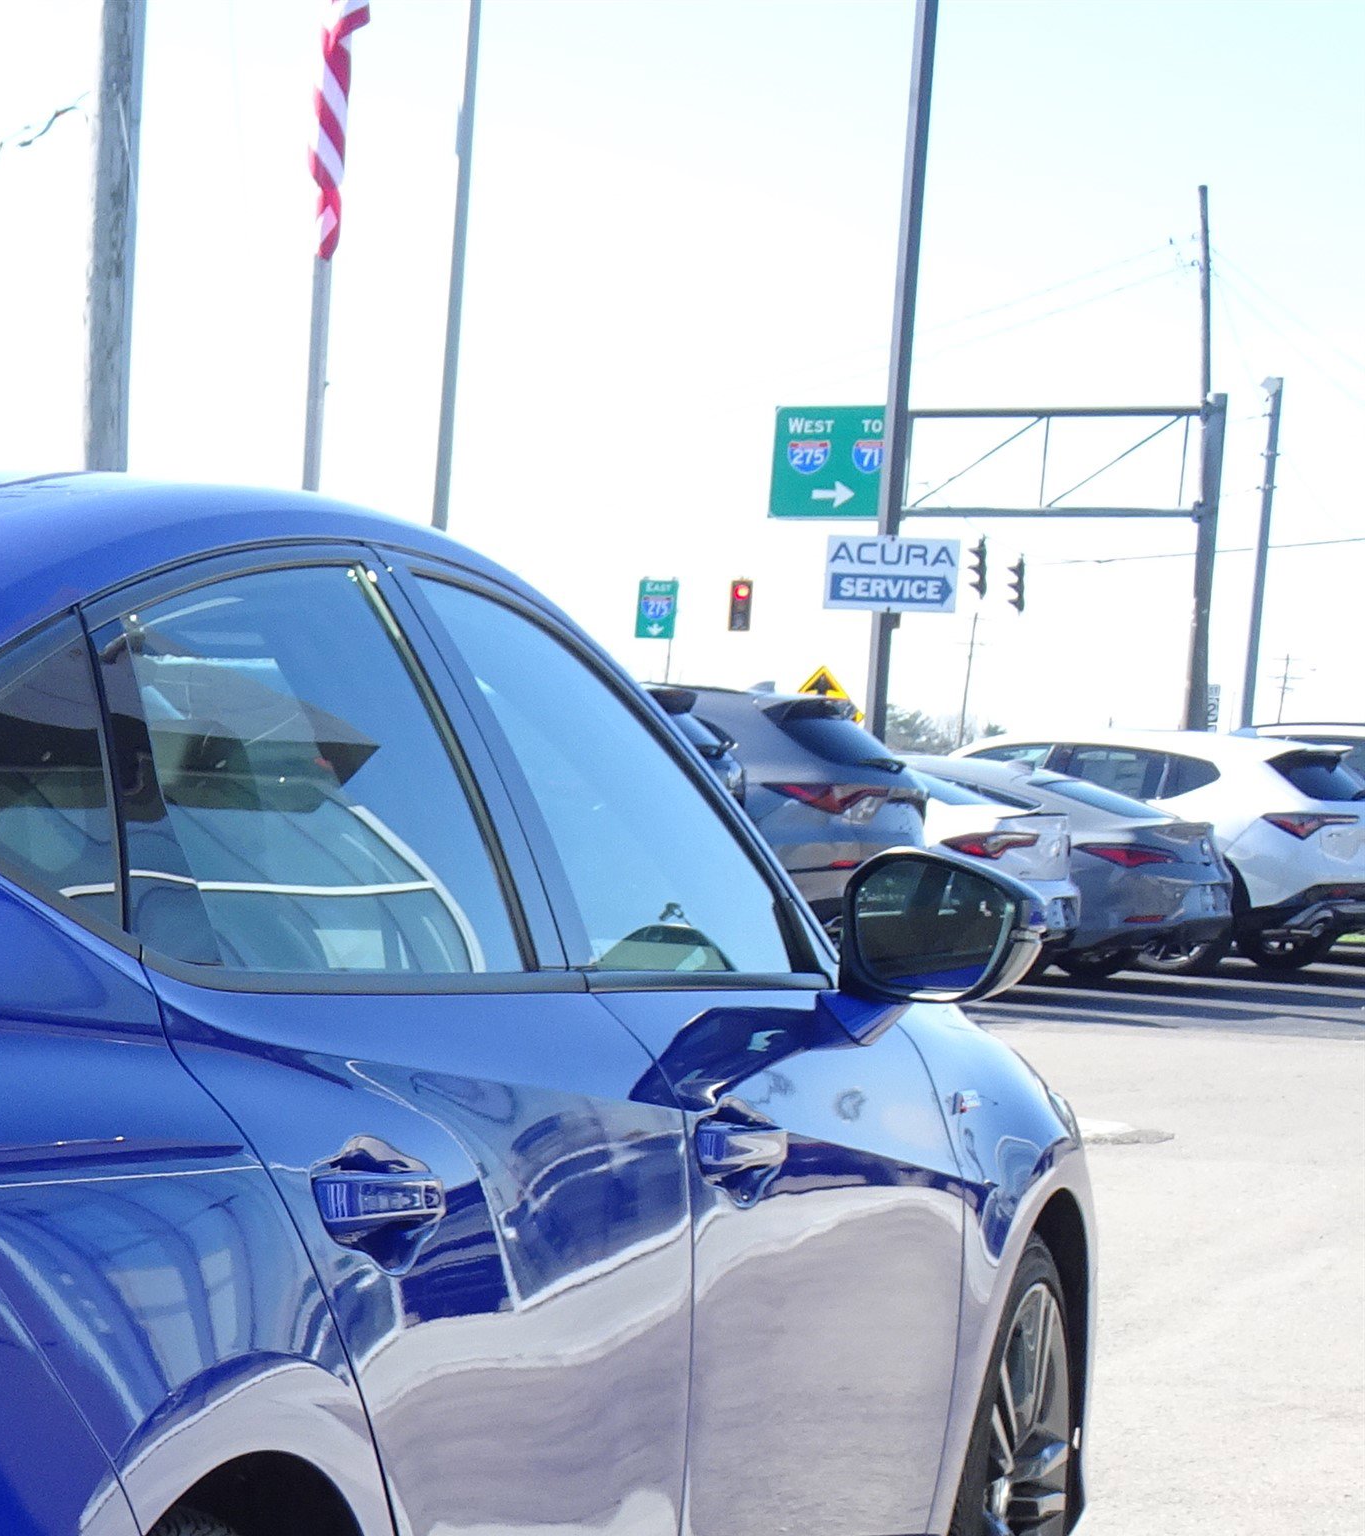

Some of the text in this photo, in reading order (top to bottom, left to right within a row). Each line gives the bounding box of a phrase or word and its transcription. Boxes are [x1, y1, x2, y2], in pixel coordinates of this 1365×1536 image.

[788, 418, 883, 433] WEST TO
[792, 448, 881, 467] 275 71
[830, 542, 956, 567] ACURA
[839, 577, 943, 600] SERVICE
[647, 600, 669, 615] 275
